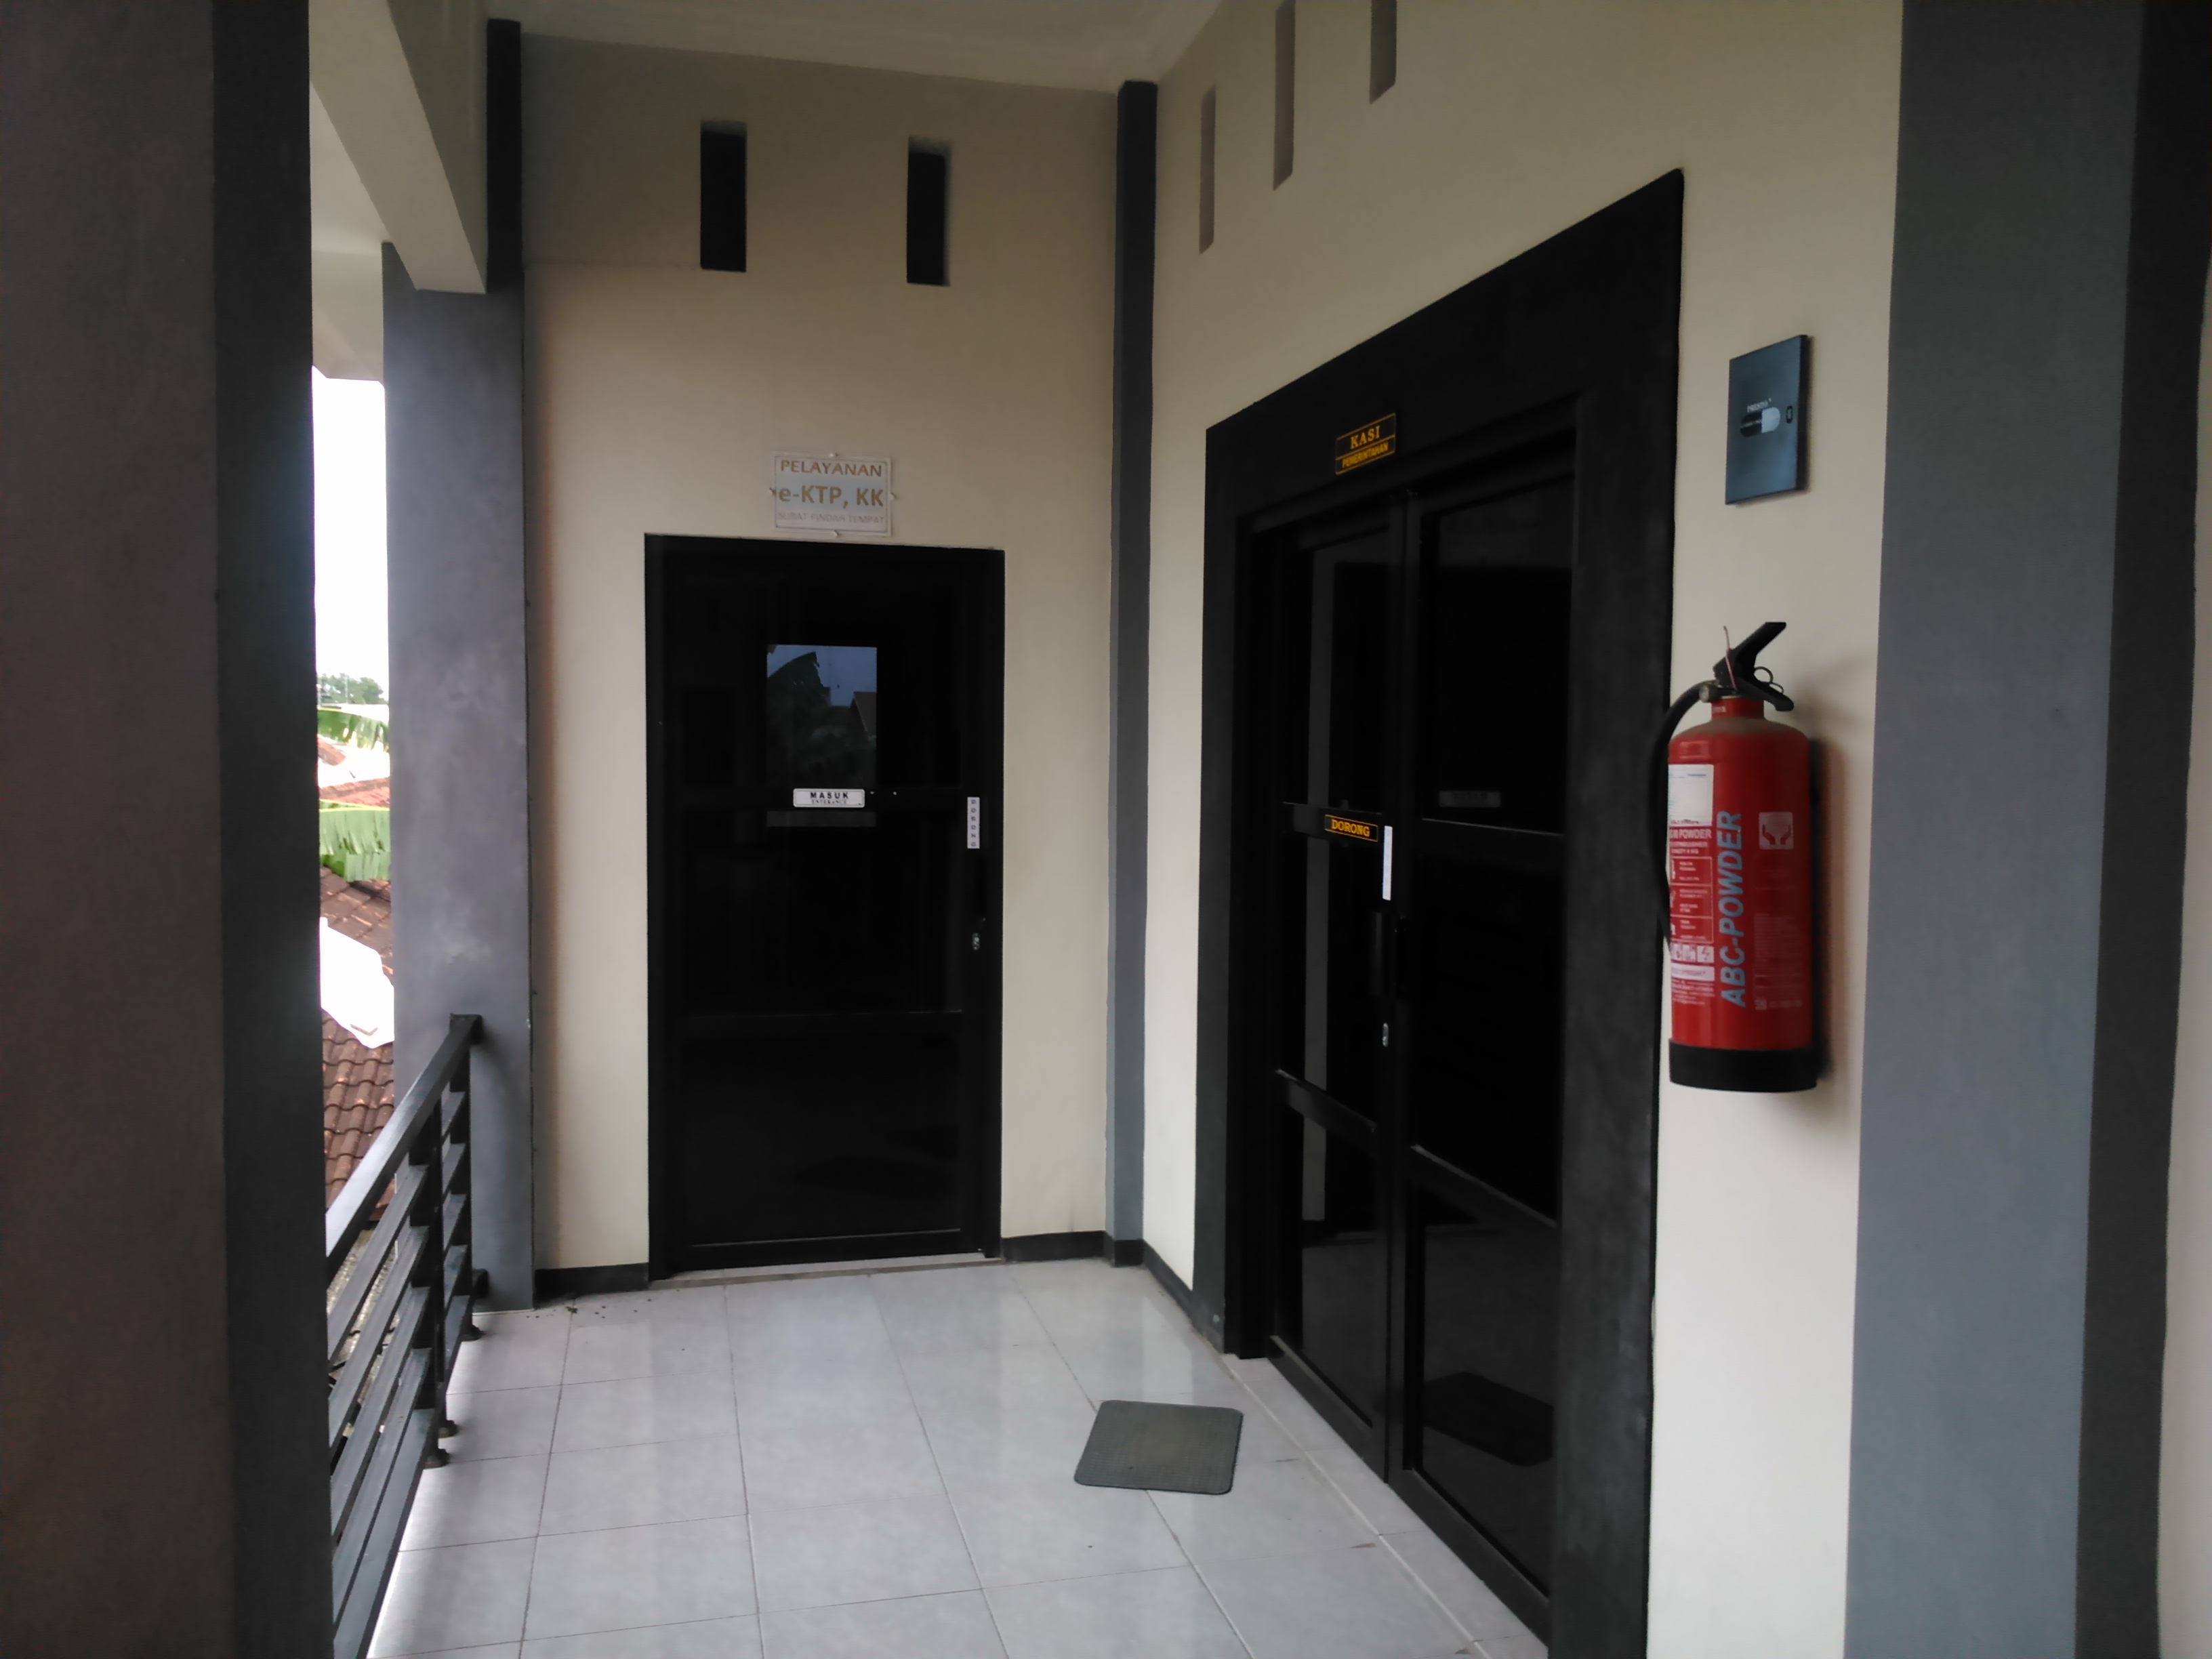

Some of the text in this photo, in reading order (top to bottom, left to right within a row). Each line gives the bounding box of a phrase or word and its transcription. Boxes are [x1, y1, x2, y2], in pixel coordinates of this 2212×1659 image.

[1350, 425, 1380, 449] KASI
[781, 459, 882, 477] PELAYANAN
[779, 485, 884, 508] e-KTP, KK
[810, 792, 848, 800] MASUK
[1331, 818, 1370, 837] DORONG
[1679, 829, 1713, 839] POWDER
[1717, 810, 1746, 1008] ABC-POWDER
